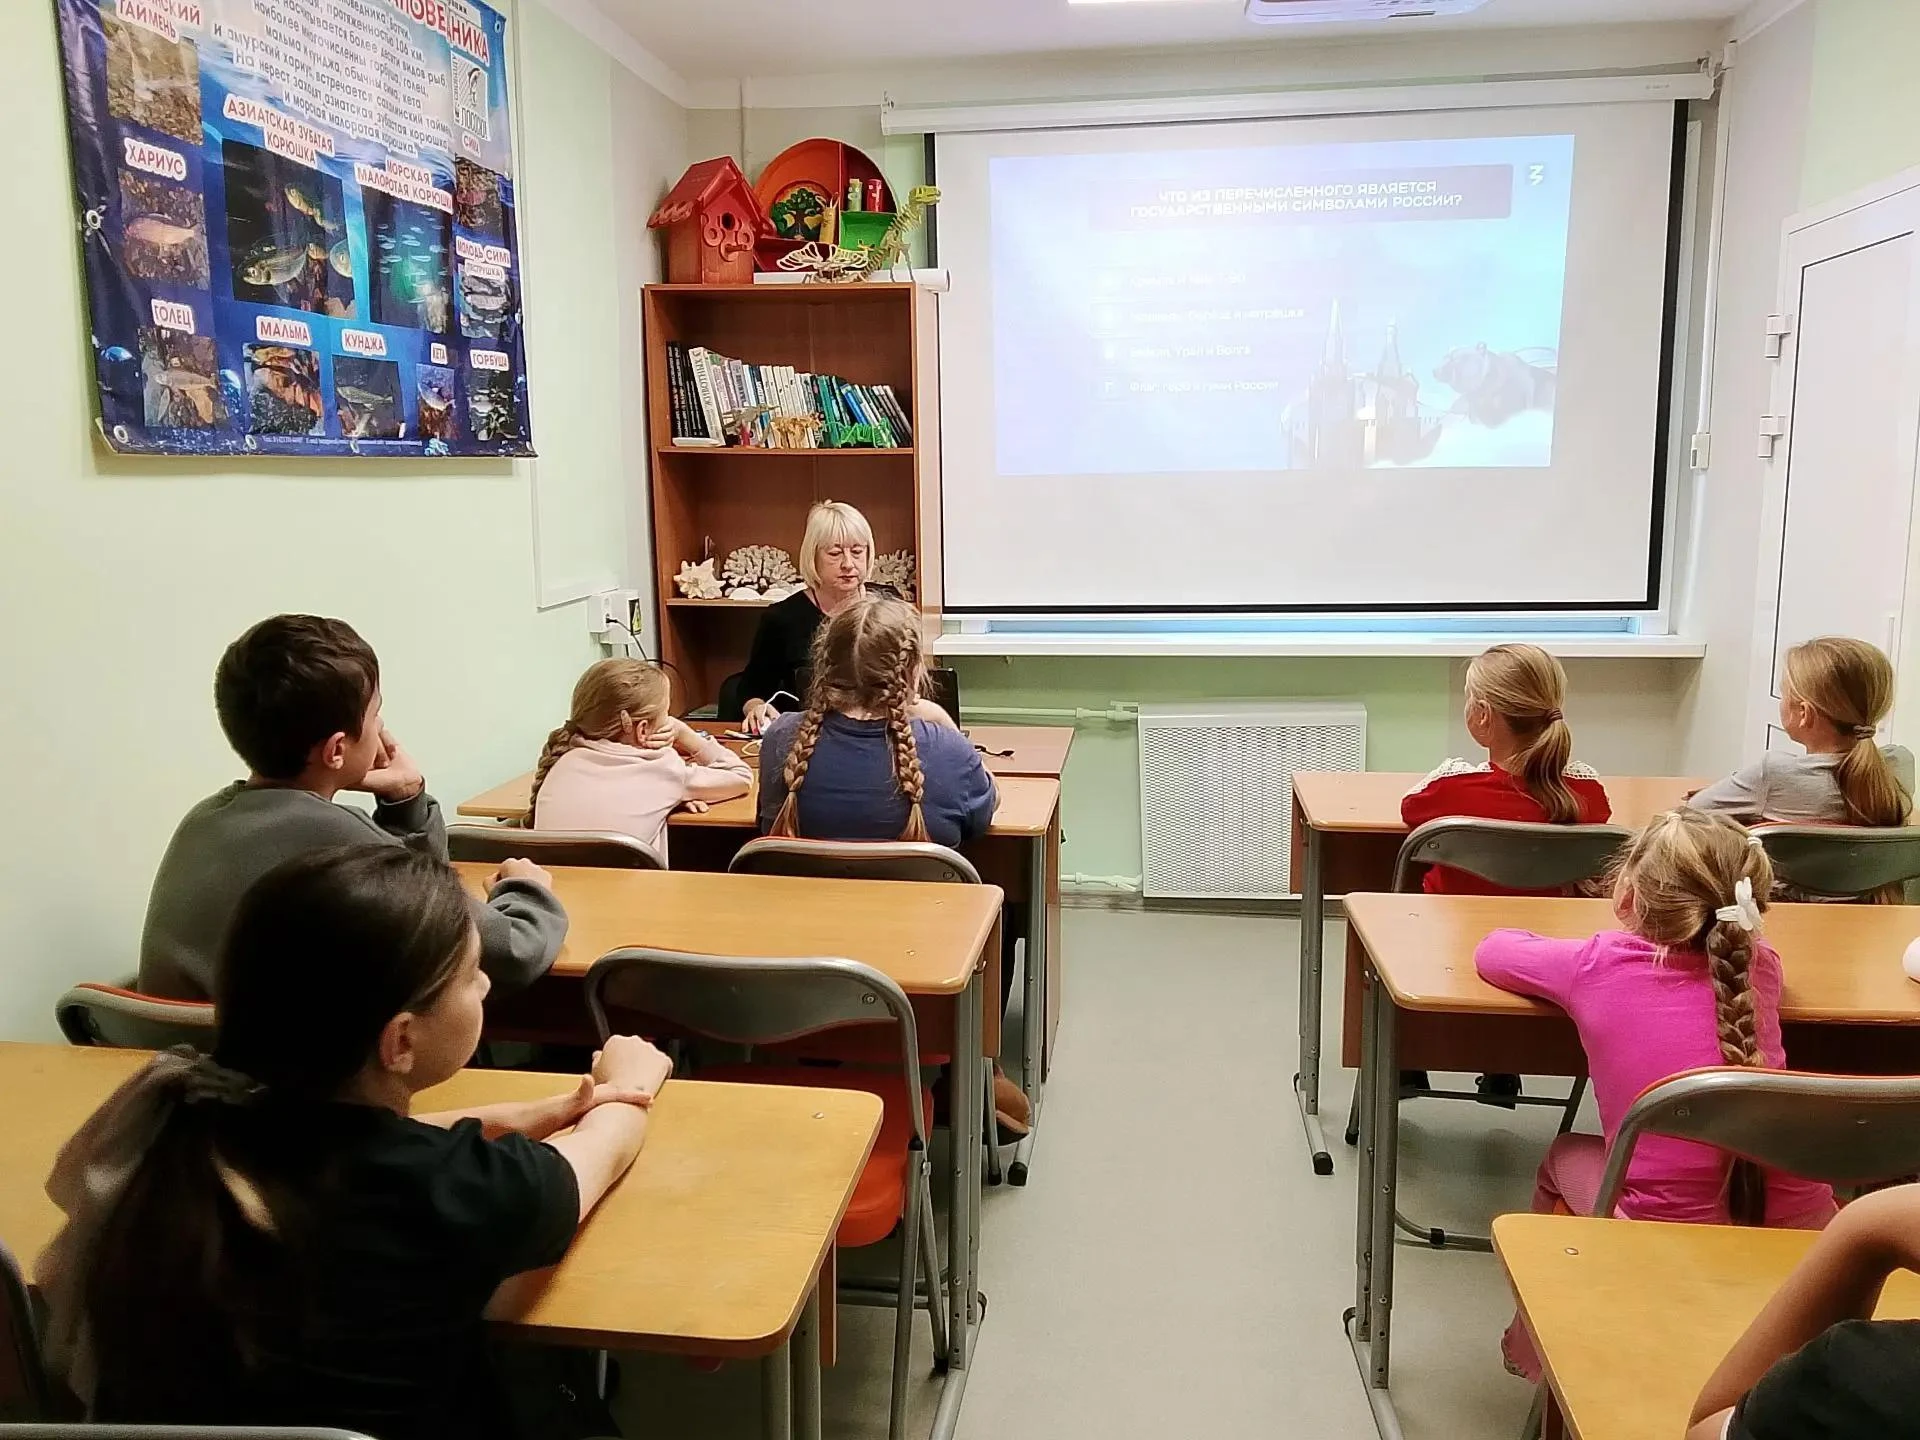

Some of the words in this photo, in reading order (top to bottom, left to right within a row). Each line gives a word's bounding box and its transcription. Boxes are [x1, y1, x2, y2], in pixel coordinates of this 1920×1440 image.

[254, 0, 299, 32] наиболее
[227, 28, 280, 60] амурский
[349, 30, 378, 54] более
[403, 61, 426, 80] видов
[265, 25, 301, 52] мальма
[402, 92, 421, 110] кета
[236, 48, 255, 67] На
[259, 59, 290, 84] нерест
[324, 92, 373, 120] азиатская
[227, 99, 296, 137] АЗИАТСКАЯ
[298, 125, 334, 154] ЗУБАТАЯ
[328, 112, 380, 140] малоротая
[128, 143, 183, 175] ХАРИУС
[267, 131, 317, 164] КОРЮШКА
[357, 167, 410, 198] МАЛОРОТАЯ
[387, 159, 430, 185] МОРСКАЯ
[1158, 190, 1187, 203] ЧТО
[1191, 189, 1211, 202] ИЗ
[1214, 183, 1354, 202] ПЕРЕЧИСЛЕННОГО
[1357, 180, 1438, 196] ЯВЛЯЕТСЯ
[1130, 201, 1288, 219] ГОСУДАРСТВЕННЫМИ
[1291, 197, 1388, 213] СИМВОЛАМИ
[1392, 194, 1464, 209] РОССИИ?
[154, 304, 193, 329] ГОЛЕЦ
[260, 320, 310, 343] МАЛЬМА
[344, 332, 385, 352] КУНДЖА
[432, 346, 447, 361] КЕТА
[473, 352, 508, 369] ГОРБУША
